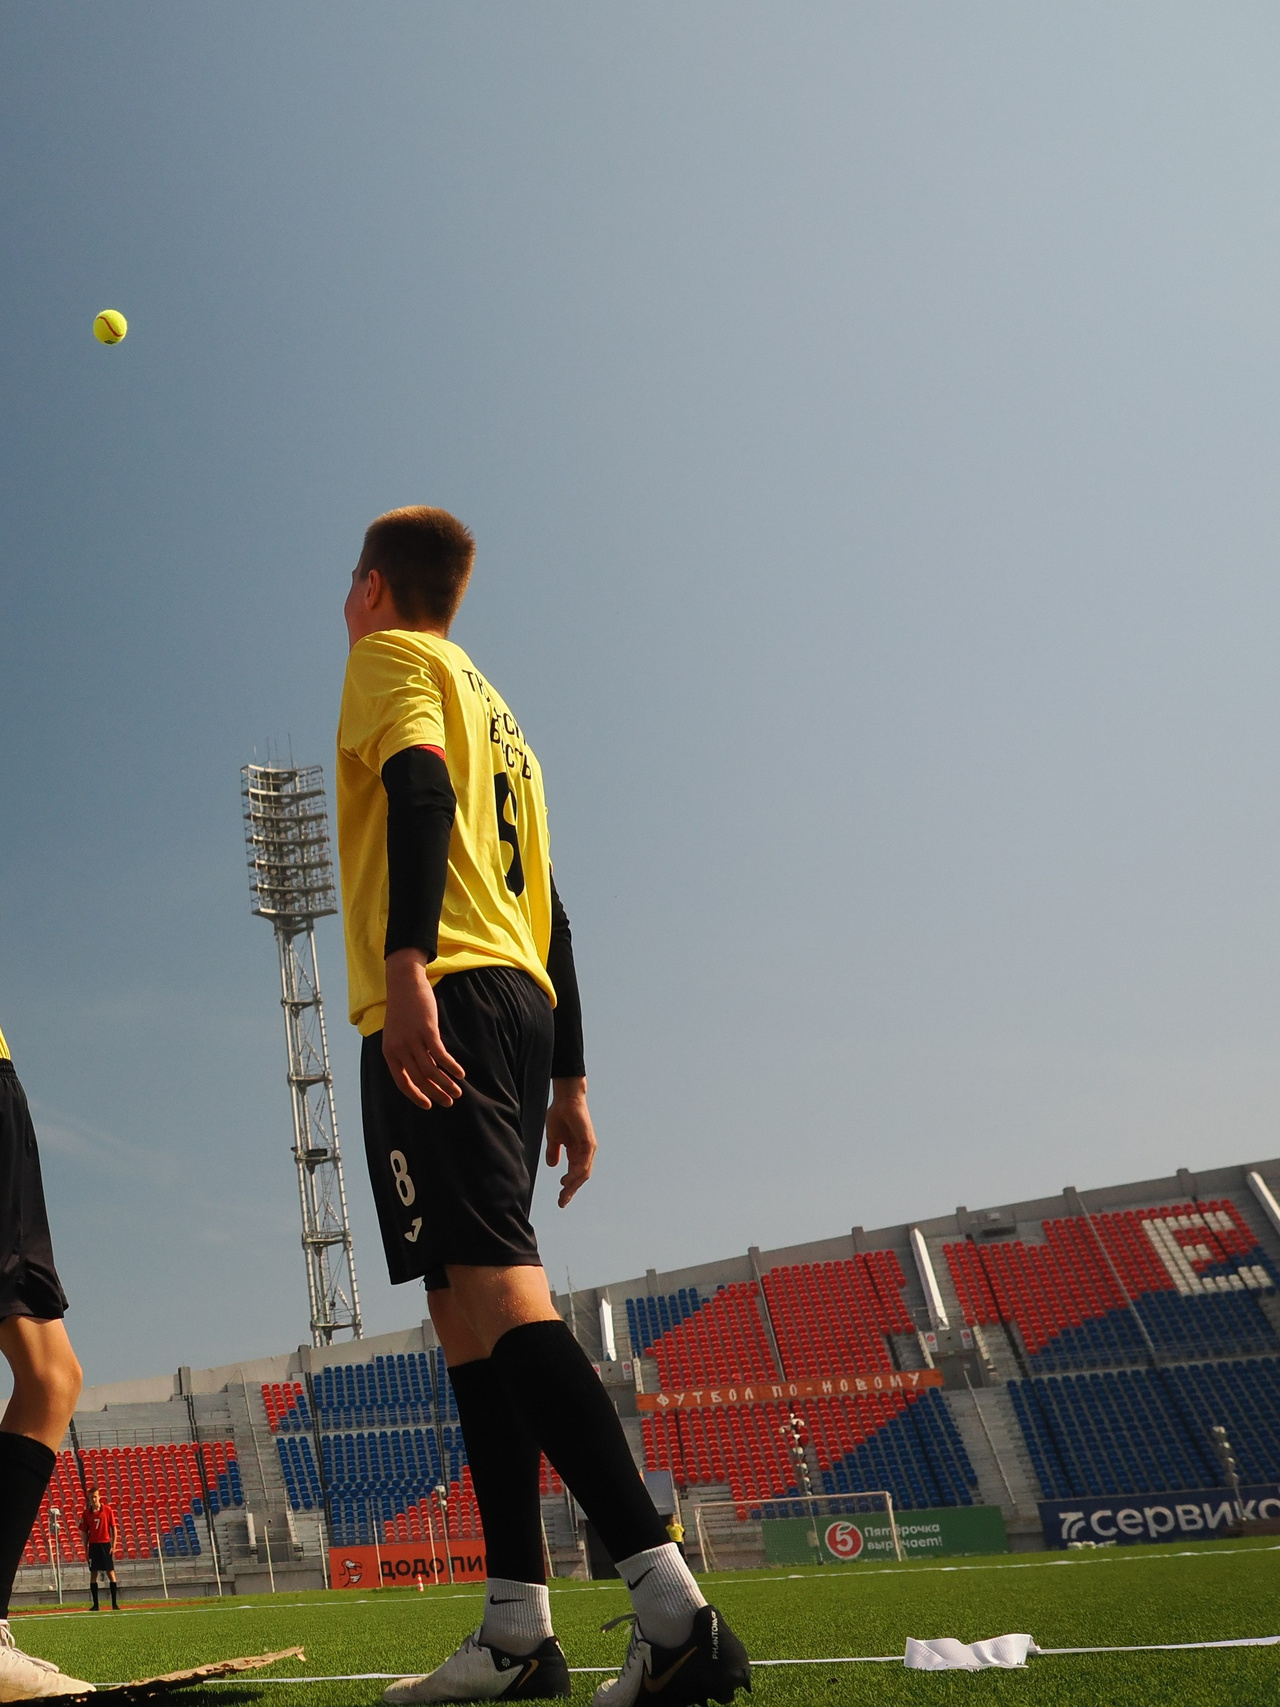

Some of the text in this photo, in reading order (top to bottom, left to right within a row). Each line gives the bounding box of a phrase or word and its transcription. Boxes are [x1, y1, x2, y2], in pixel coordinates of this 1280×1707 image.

[390, 1149, 416, 1207] 8
[656, 1372, 920, 1407] ФУТБОЛ ПО-НОВОМУ
[93, 1518, 101, 1530] 7
[867, 1536, 943, 1552] вырчает!
[711, 1618, 719, 1660] PHANTOM
